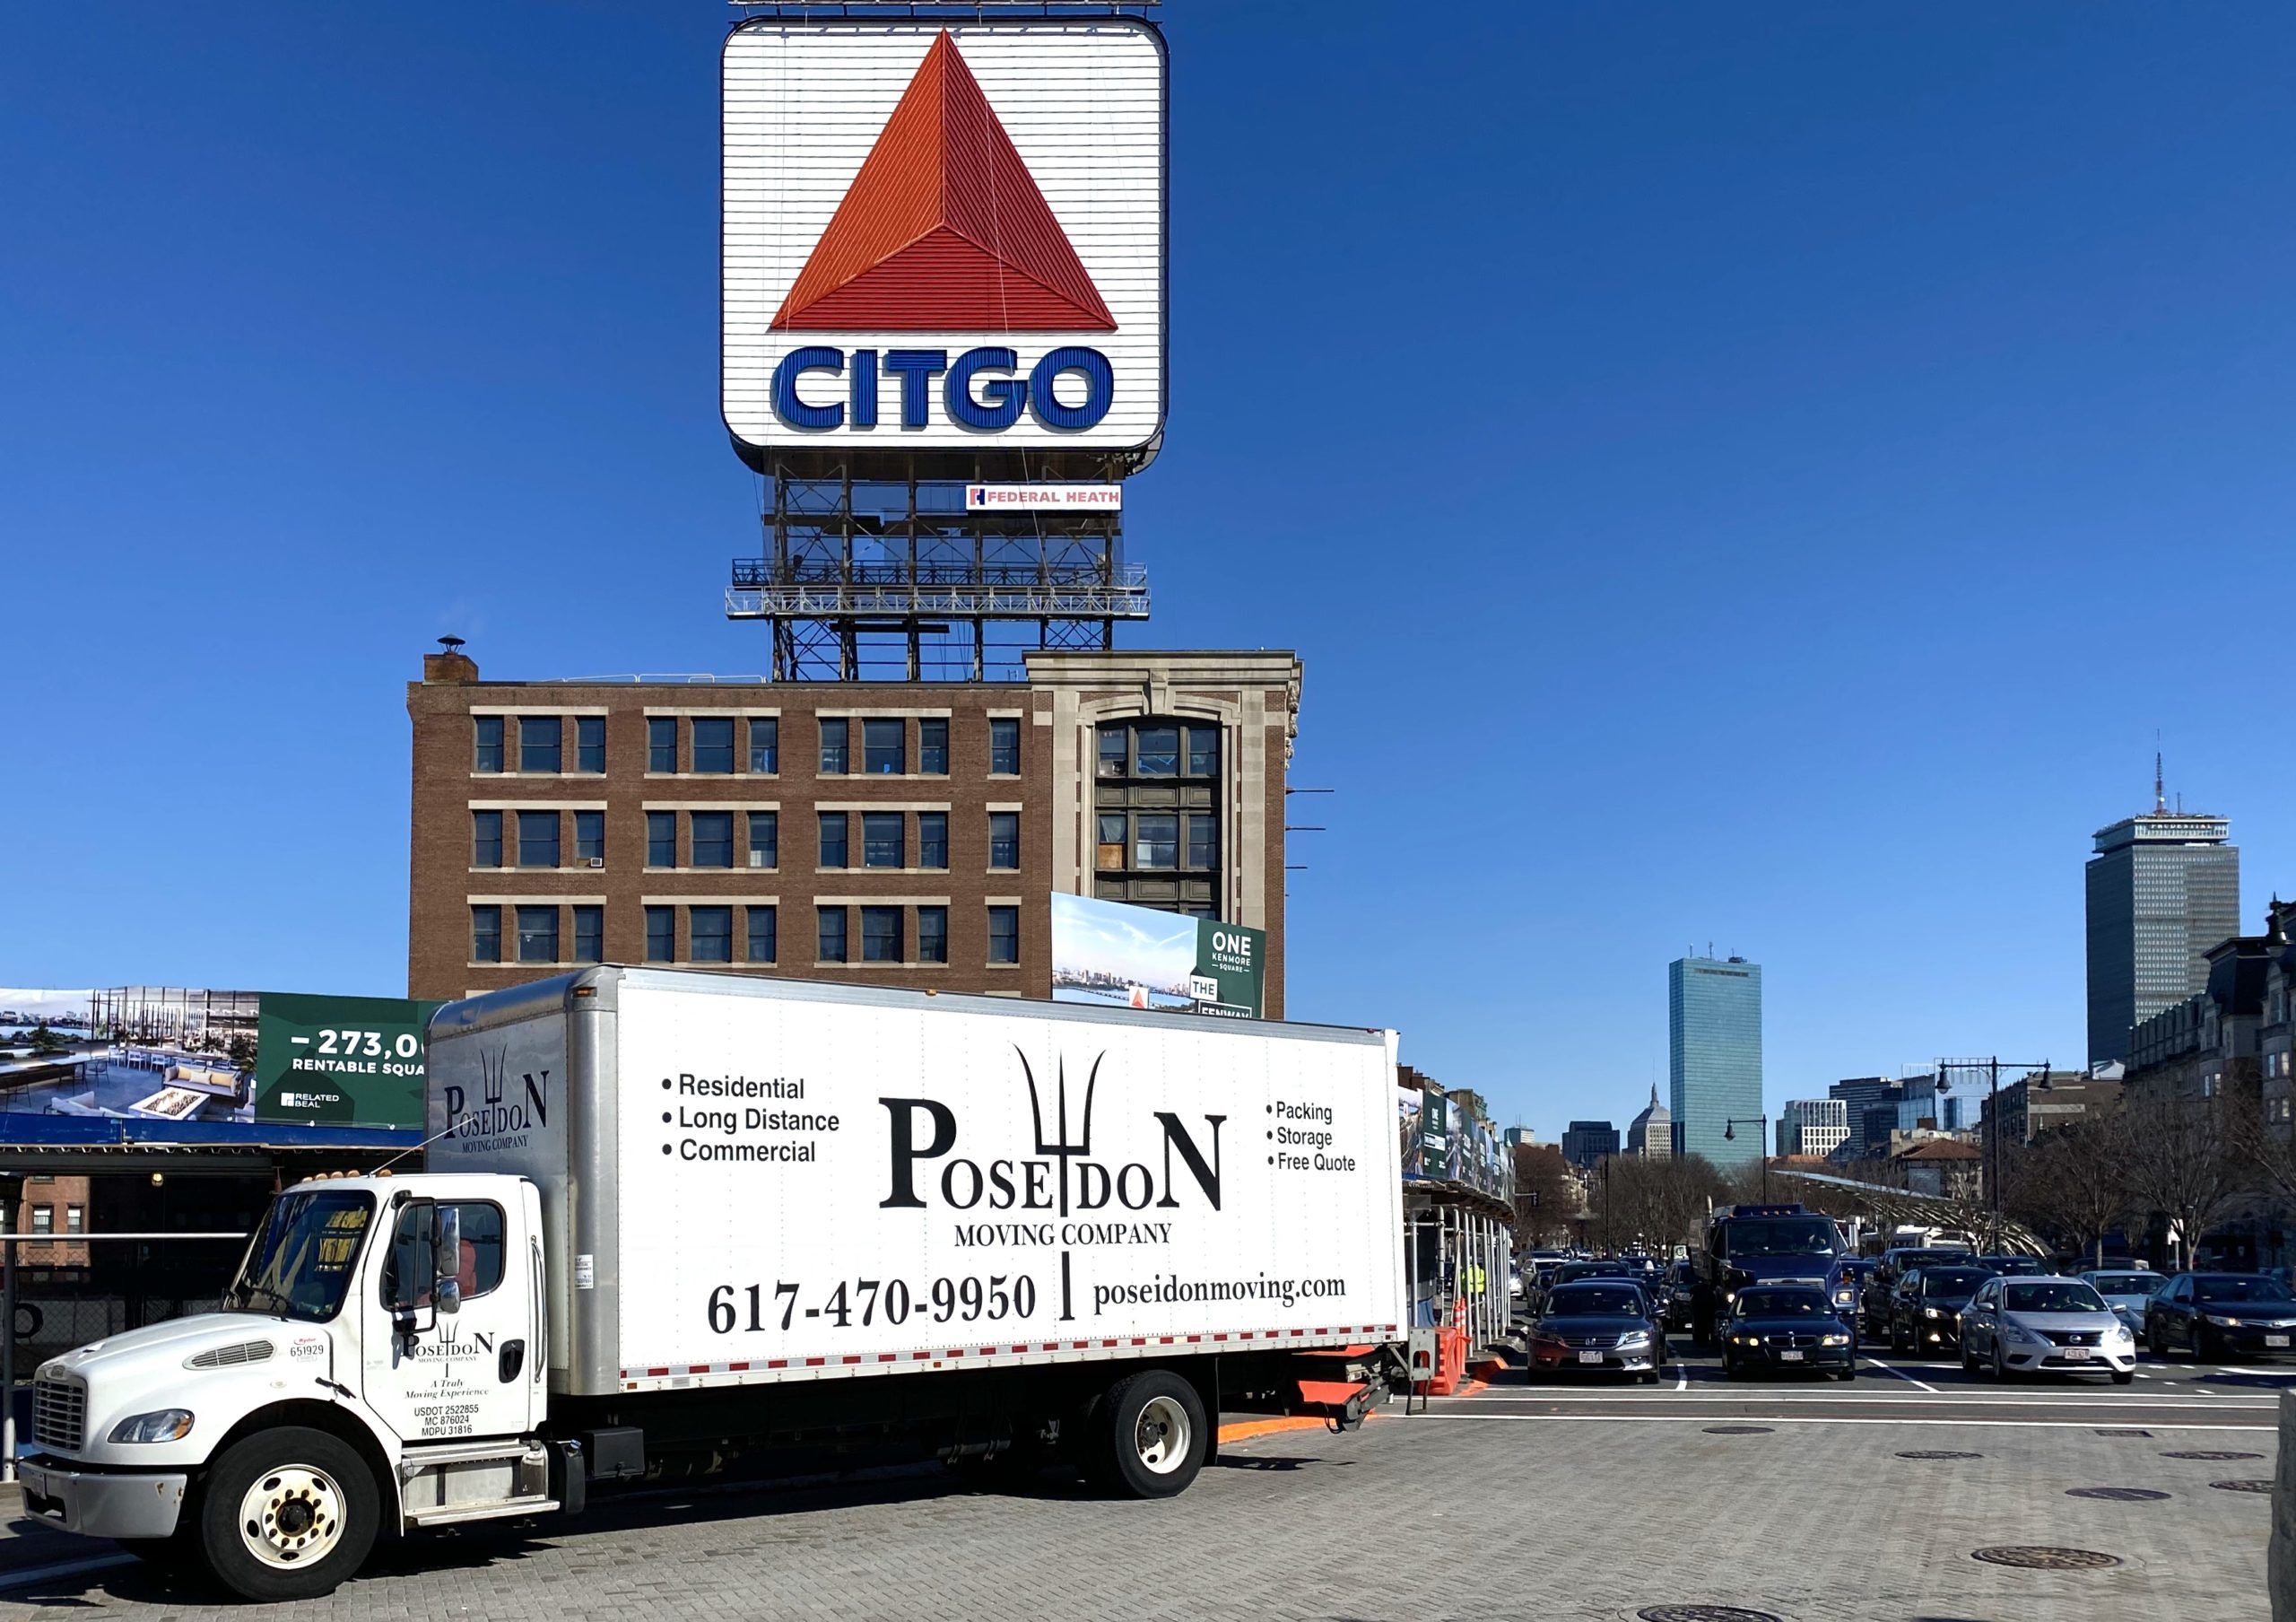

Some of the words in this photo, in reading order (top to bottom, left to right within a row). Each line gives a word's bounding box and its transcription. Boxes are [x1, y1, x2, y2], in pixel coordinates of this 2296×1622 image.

[772, 345, 1114, 429] CITGO
[987, 492, 1061, 502] FEDERAL
[1066, 492, 1119, 502] HEATH
[1213, 931, 1252, 956] ONE
[1212, 953, 1251, 966] KENMORE
[1219, 964, 1243, 973] SQUARE
[1193, 981, 1215, 996] THE
[317, 1029, 424, 1060] 273,0
[292, 1058, 377, 1074] RENTABLE
[382, 1062, 424, 1077] SQUA
[679, 1073, 804, 1099] Residential
[294, 1100, 321, 1108] BEAL
[295, 1093, 340, 1103] RELATED
[443, 1069, 550, 1140] POSEIDON
[679, 1106, 737, 1135] Long
[745, 1108, 840, 1131] Distance
[1276, 1100, 1332, 1125] Packing
[462, 1137, 491, 1154] MOVING
[492, 1134, 528, 1151] COMPANY
[1277, 1126, 1333, 1150] Storage
[680, 1138, 815, 1162] Commercial
[878, 1096, 1228, 1212] POSEIDON
[1278, 1152, 1309, 1170] Free
[1314, 1153, 1356, 1172] Quote
[954, 1224, 1056, 1247] MOVING
[1061, 1223, 1172, 1245] COMPANY
[1093, 1271, 1346, 1316] poseidonmoving.com
[708, 1275, 1036, 1335] 617-470-9950
[290, 1344, 324, 1357] 651929
[403, 1331, 495, 1356] POSEIDON
[430, 1380, 438, 1388] A
[440, 1378, 465, 1389] Truly
[404, 1390, 438, 1400] Moving
[440, 1388, 490, 1400] Experience
[413, 1406, 443, 1417] USDOT
[445, 1404, 479, 1416] 2522855
[424, 1417, 439, 1426] MC
[439, 1415, 470, 1426] 876024
[422, 1427, 447, 1437] MDPU
[448, 1425, 473, 1435] 31816
